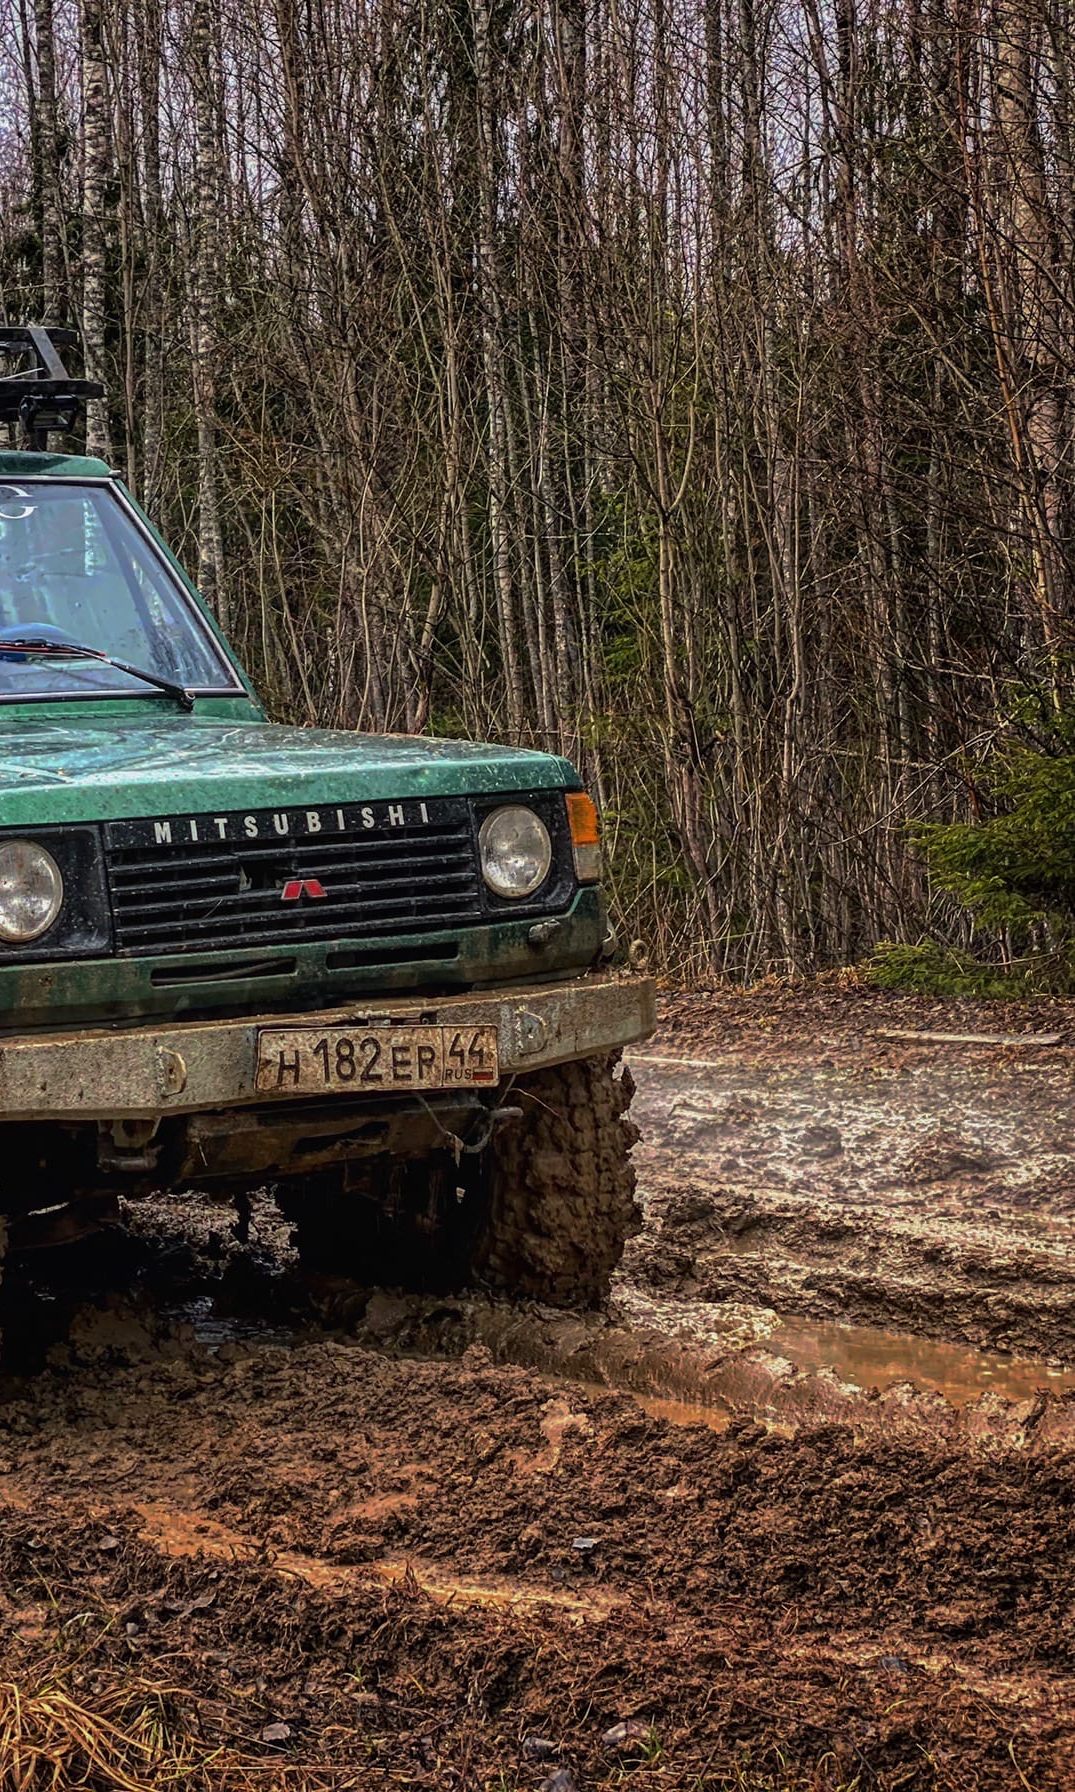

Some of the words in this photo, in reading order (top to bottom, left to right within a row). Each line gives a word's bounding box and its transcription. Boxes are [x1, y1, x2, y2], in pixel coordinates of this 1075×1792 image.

[154, 803, 429, 844] MITSUBISHI
[449, 1032, 485, 1068] 44
[444, 1067, 472, 1081] RUS
